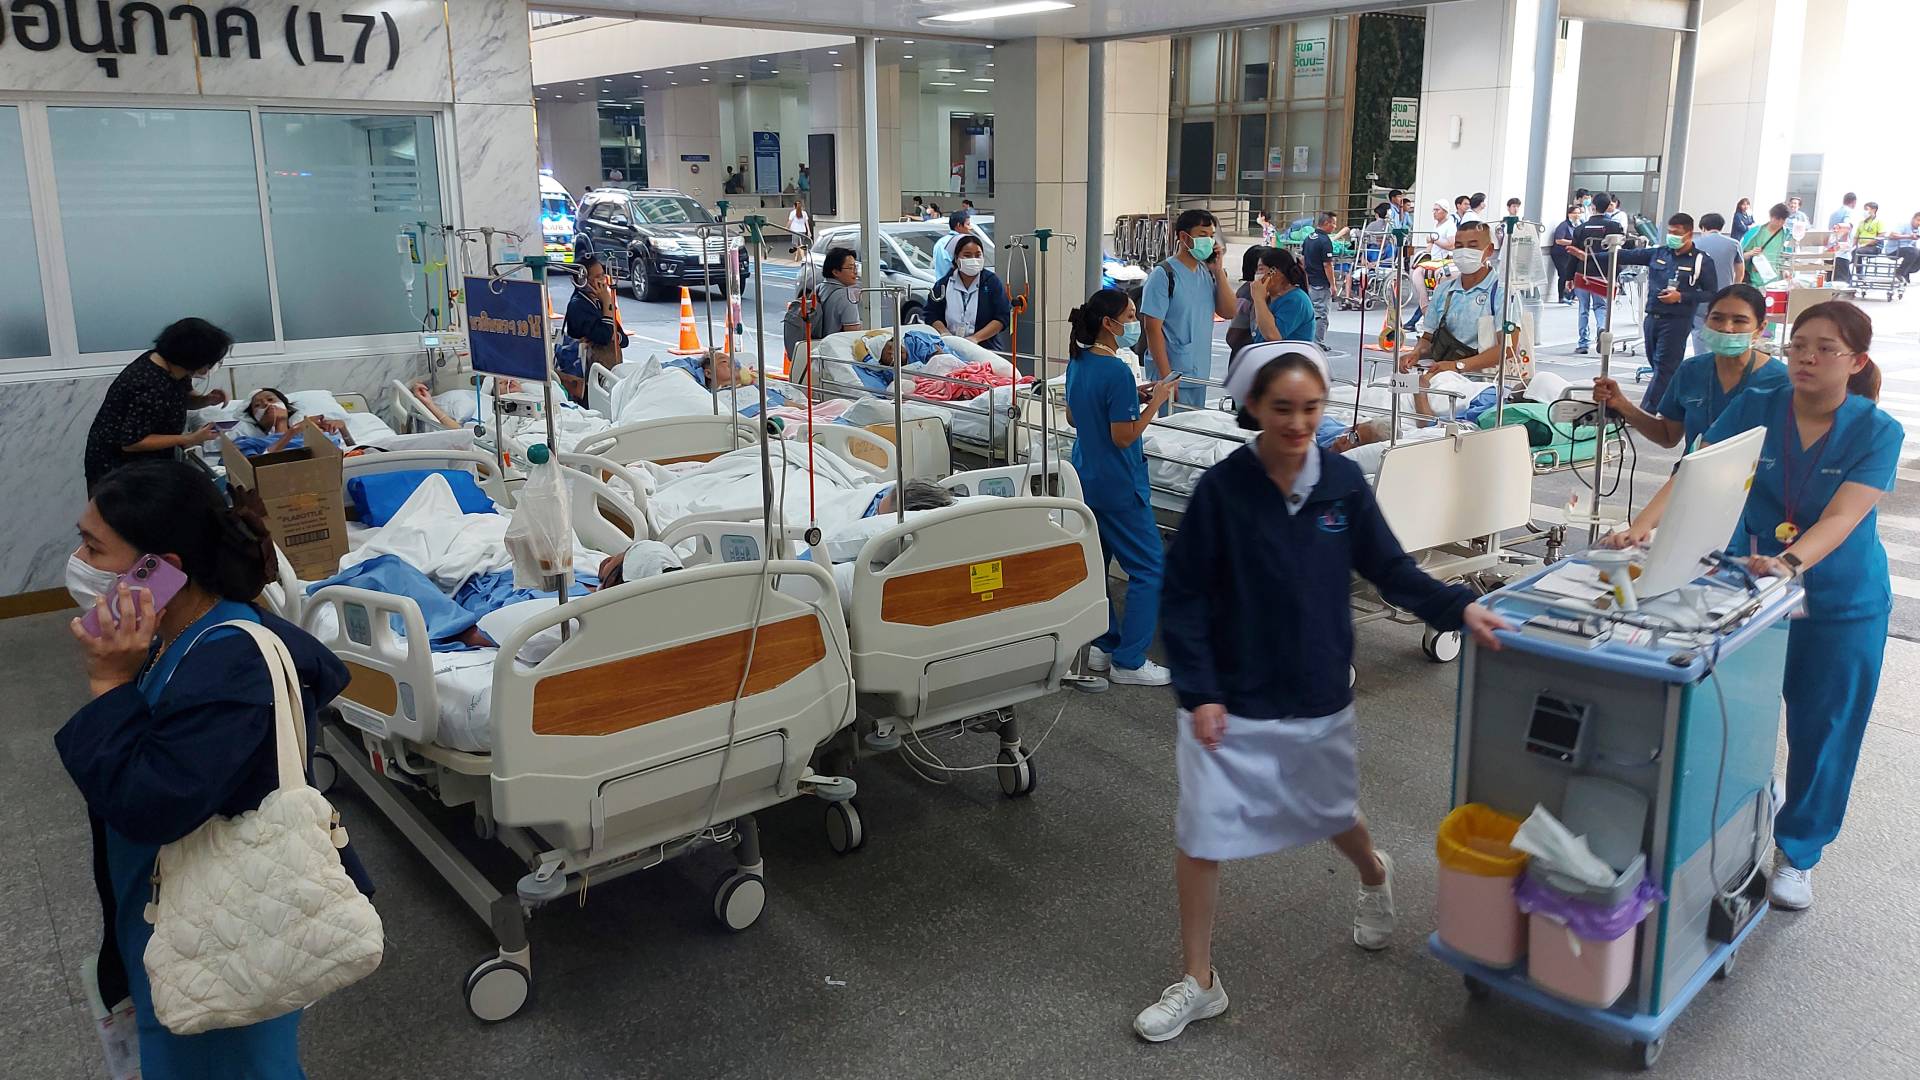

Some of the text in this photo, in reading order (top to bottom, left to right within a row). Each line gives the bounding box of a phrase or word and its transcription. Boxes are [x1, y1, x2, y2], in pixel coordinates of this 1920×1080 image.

[0, 0, 401, 79] อนุภาค (L7)
